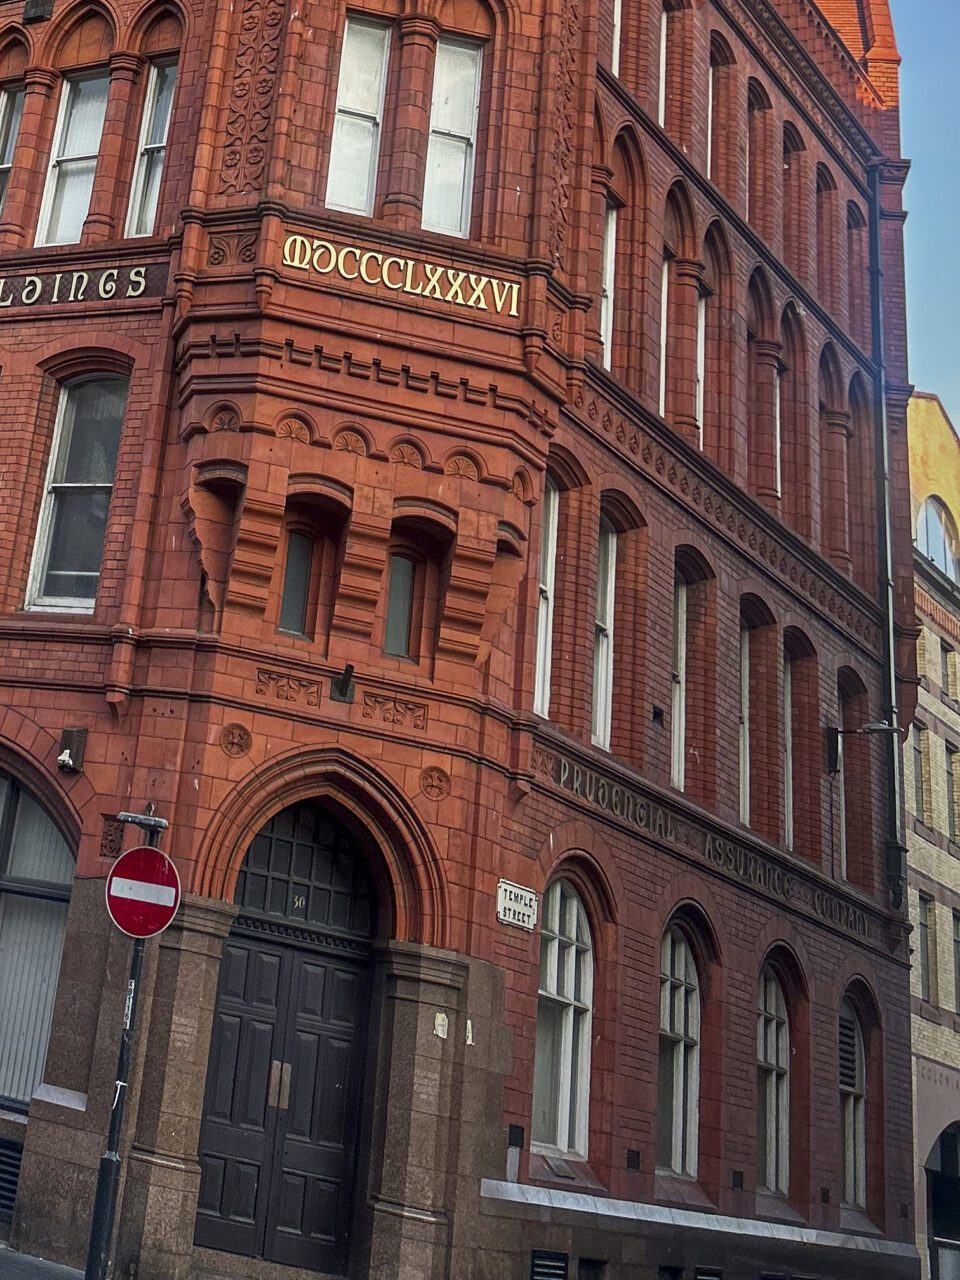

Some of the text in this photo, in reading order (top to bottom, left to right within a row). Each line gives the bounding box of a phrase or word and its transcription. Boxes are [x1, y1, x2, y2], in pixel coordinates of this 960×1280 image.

[282, 234, 520, 317] MDCCCLXXXVI
[560, 757, 675, 841] PRUDENTIAL
[705, 833, 791, 898] ASSURANCE
[294, 895, 305, 909] 30
[503, 888, 533, 908] TEMPLE
[503, 906, 531, 925] STREET
